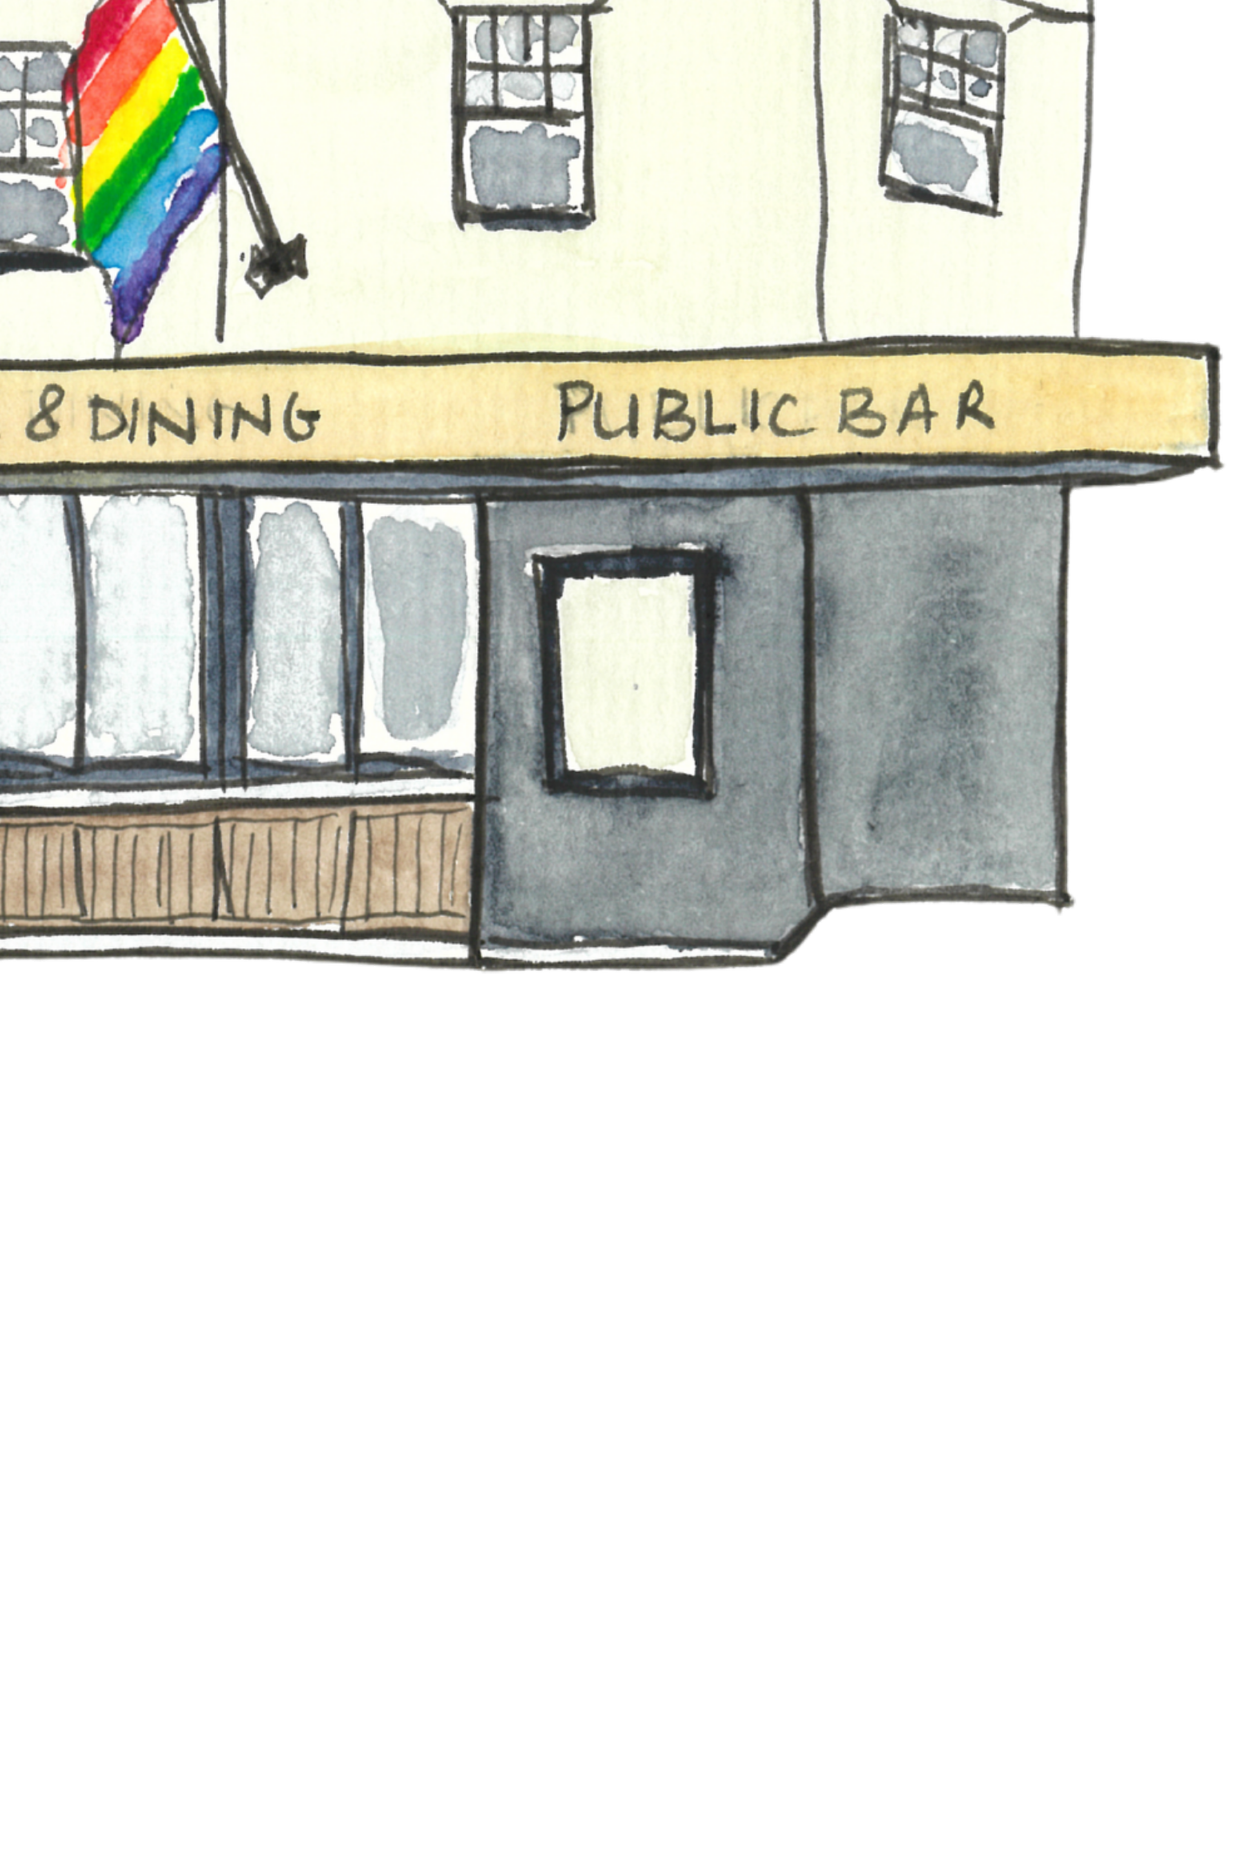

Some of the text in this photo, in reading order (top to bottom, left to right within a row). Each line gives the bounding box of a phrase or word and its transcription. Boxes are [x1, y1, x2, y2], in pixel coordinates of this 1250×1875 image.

[25, 383, 66, 443] &
[88, 390, 321, 448] DINING
[556, 378, 996, 443] PUBLIC BAR
